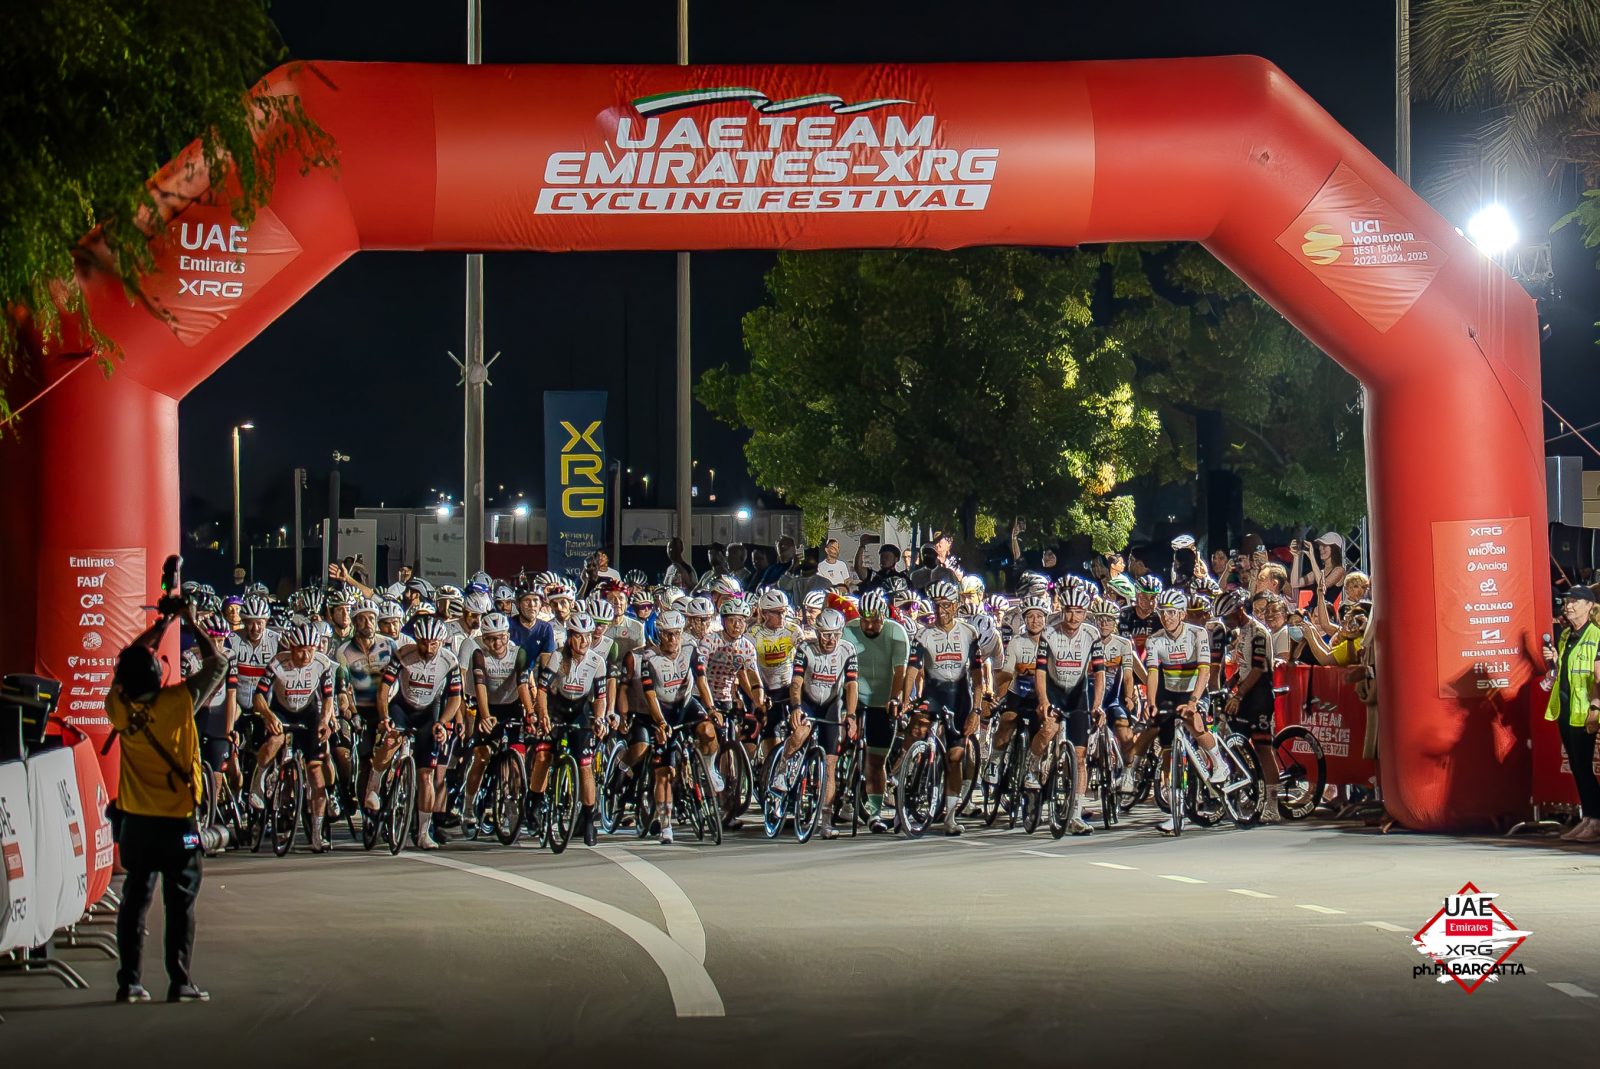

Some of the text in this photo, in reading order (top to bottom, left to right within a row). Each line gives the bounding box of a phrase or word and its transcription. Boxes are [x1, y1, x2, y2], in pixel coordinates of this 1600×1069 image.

[616, 116, 935, 149] UAE TEAM
[543, 148, 1000, 184] EMIRATES-XRG
[551, 189, 976, 211] CYCLING FESTIVAL
[1350, 220, 1380, 234] UCI
[180, 223, 248, 253] UAE
[1352, 232, 1415, 246] WORLDTOUR
[1353, 243, 1402, 255] BEST TEAM
[1408, 252, 1428, 262] 2025
[180, 255, 246, 274] Emirates
[178, 278, 243, 297] XRG
[559, 420, 605, 518] XRG
[1470, 527, 1502, 536] XRG
[69, 557, 115, 568] Emirates
[1477, 562, 1508, 571] Analog
[80, 594, 104, 609] G42
[1474, 602, 1513, 611] COLNAGO
[79, 613, 105, 627] ADQ
[1469, 615, 1510, 625] SHIMANO
[1132, 627, 1152, 635] UAE
[764, 643, 785, 653] UAE
[936, 643, 961, 653] UAE
[1168, 644, 1185, 653] UAE
[1462, 647, 1519, 658] RICHARD MILLE
[238, 651, 271, 664] UAE
[1057, 650, 1082, 660] UAE
[814, 664, 837, 674] UAE
[73, 672, 110, 682] MET
[410, 672, 435, 684] UAE
[566, 677, 585, 685] UAE
[286, 680, 311, 689] UAE
[70, 687, 111, 696] ELITE
